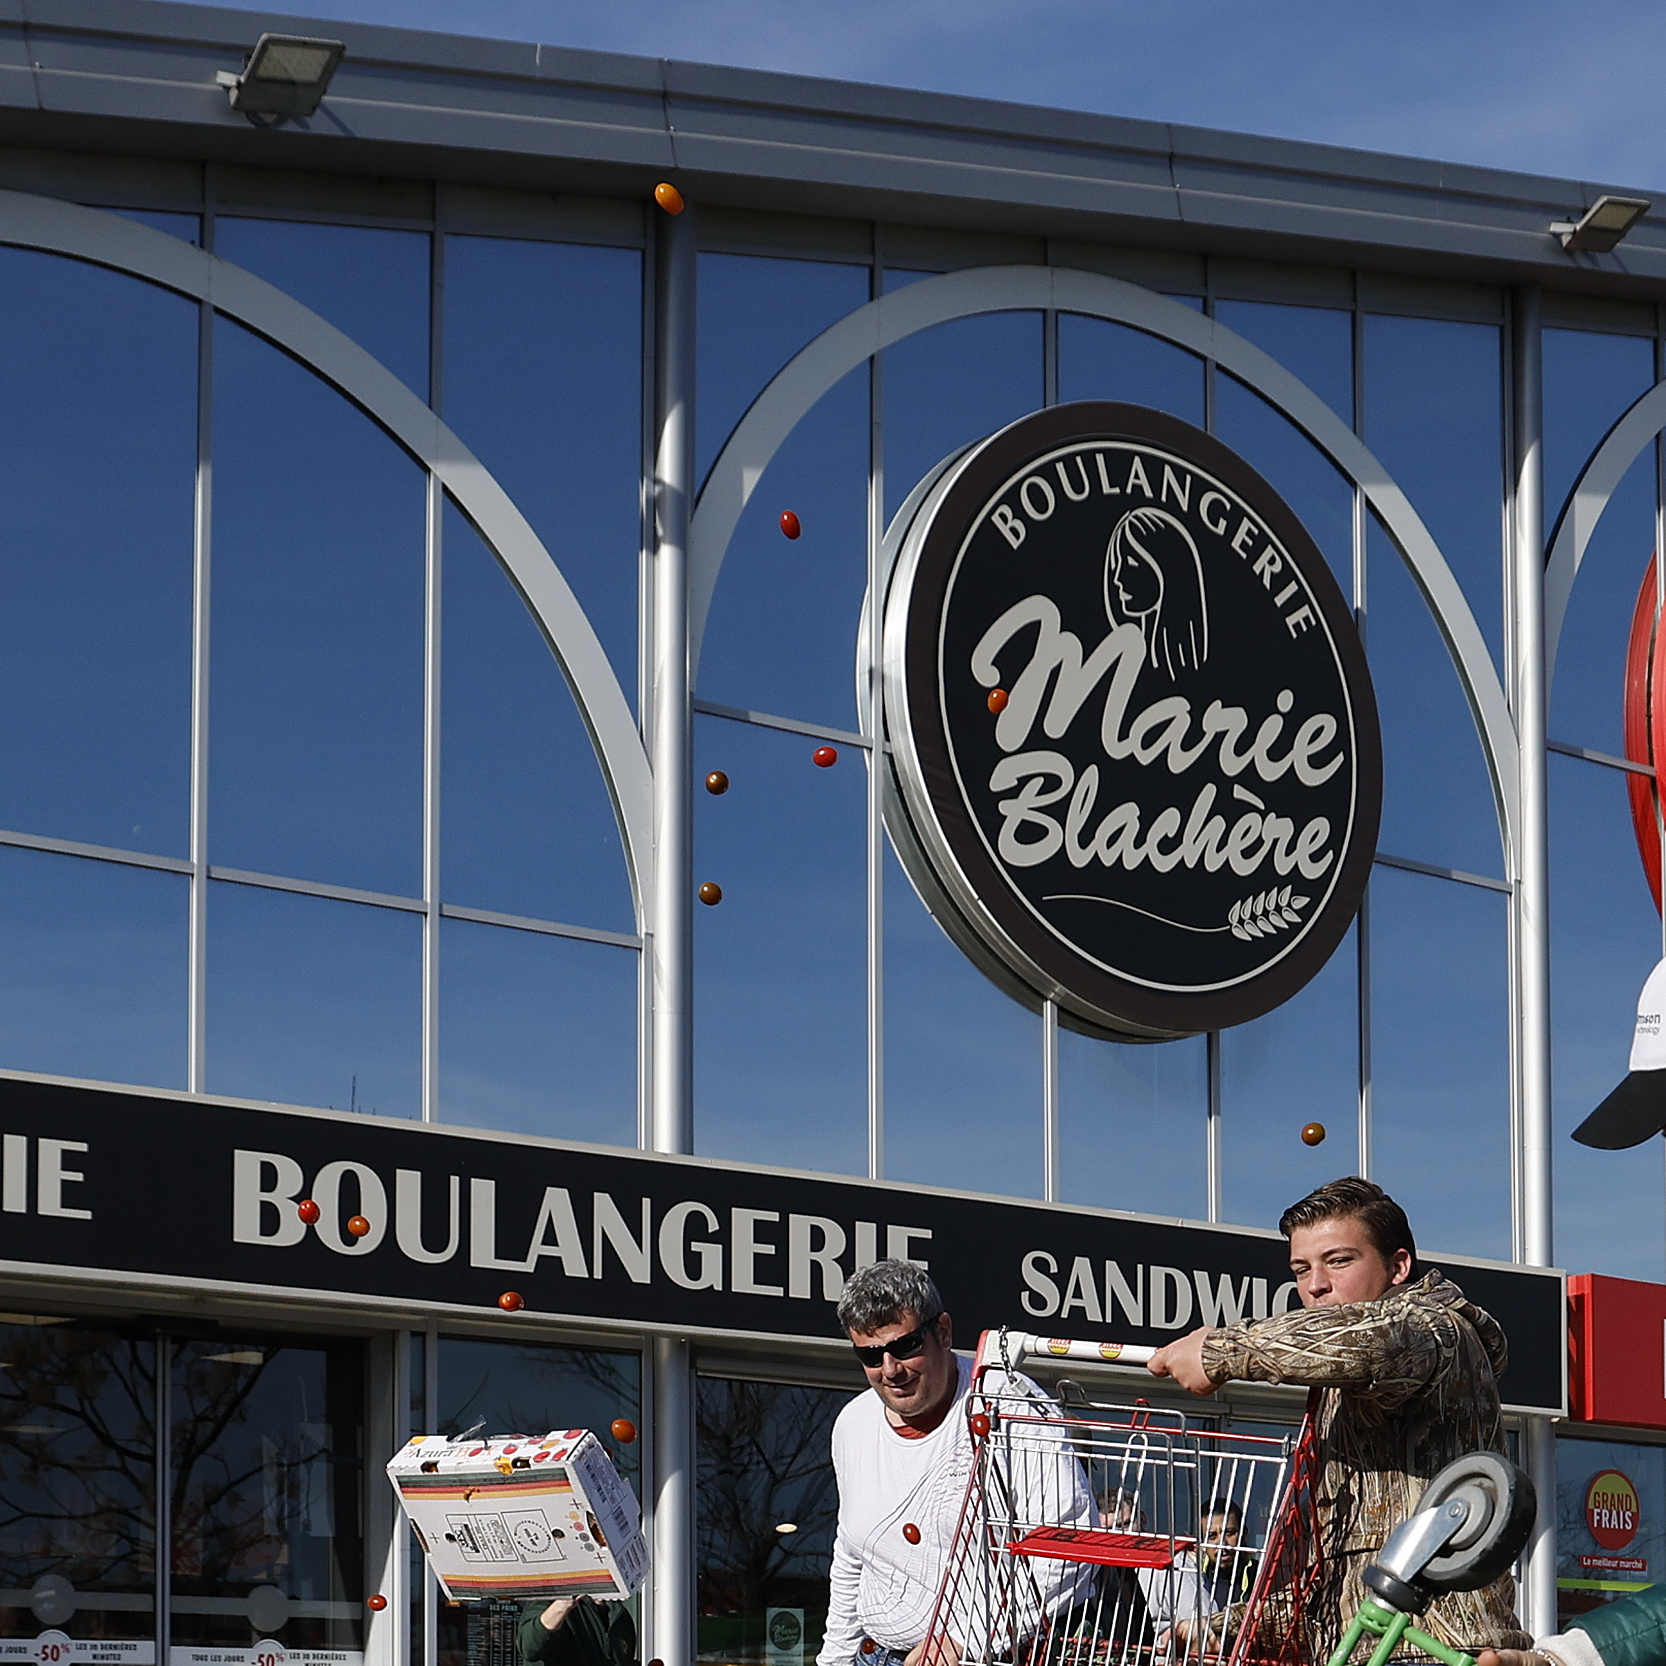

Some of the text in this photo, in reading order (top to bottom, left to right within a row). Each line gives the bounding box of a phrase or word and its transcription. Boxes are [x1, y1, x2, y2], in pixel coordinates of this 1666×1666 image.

[990, 452, 1318, 641] BOULANGERIE
[971, 594, 1346, 787] Marie
[988, 750, 1334, 880] Blachère
[409, 1447, 454, 1459] Azura
[1593, 1491, 1632, 1511] GRAND
[1593, 1508, 1633, 1531] FRAIS
[1583, 1556, 1643, 1570] Le meilleur marché
[5, 1646, 27, 1654] JOURS
[92, 1653, 121, 1661] MINUTES
[289, 1652, 300, 1660] LES
[191, 1653, 208, 1662] TOUS
[210, 1654, 222, 1662] LES
